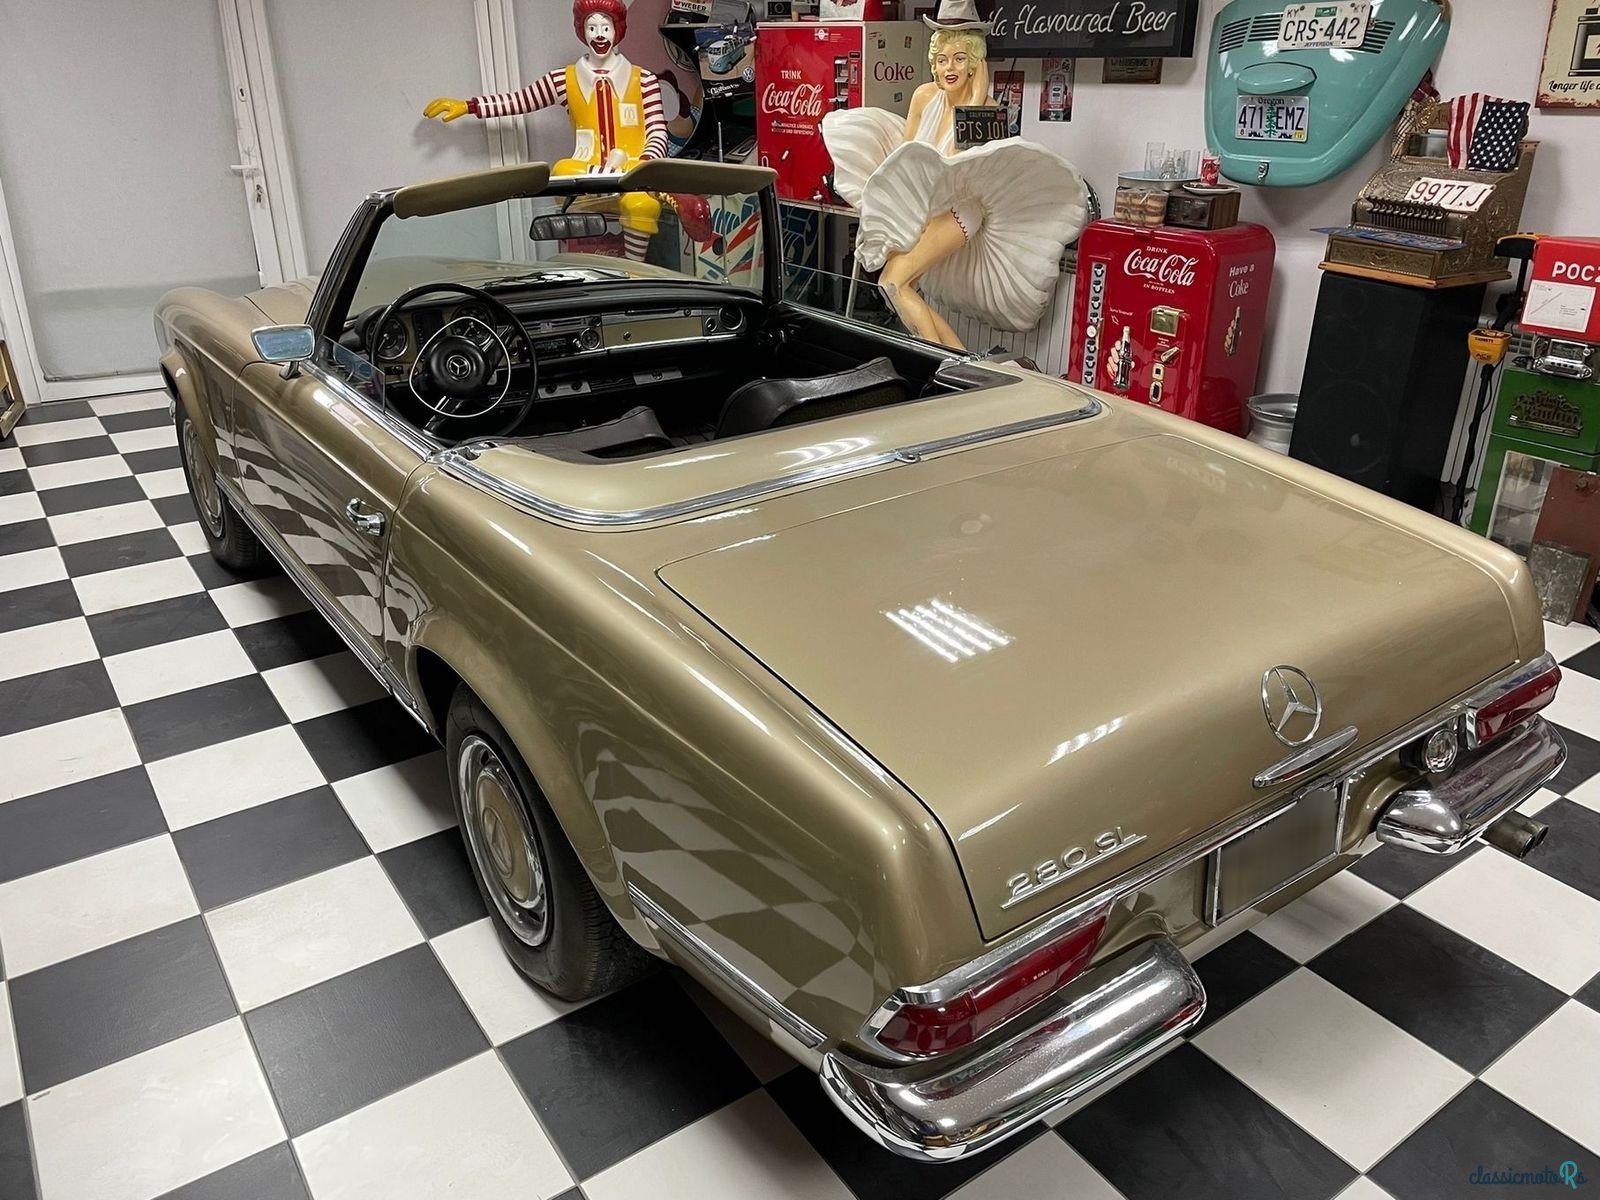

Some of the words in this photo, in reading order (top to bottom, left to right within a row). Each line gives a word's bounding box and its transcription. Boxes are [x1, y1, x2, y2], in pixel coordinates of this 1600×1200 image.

[681, 1, 707, 11] WEBER
[1287, 8, 1299, 17] KY
[1014, 2, 1119, 40] flavoured
[1122, 1, 1177, 34] Beer
[781, 70, 802, 80] TRINK
[874, 61, 914, 81] Coke
[1549, 80, 1579, 92] Longer
[1580, 80, 1595, 92] life
[762, 83, 823, 116] Coca-Cola
[1258, 97, 1285, 106] Oregon
[1238, 106, 1264, 129] 471
[1276, 107, 1305, 130] EMZ
[958, 121, 983, 140] PTS
[987, 121, 1005, 140] 101
[1146, 245, 1168, 254] DRINK
[1123, 248, 1199, 286] Coca-Cola
[1229, 265, 1248, 277] Have
[1249, 264, 1255, 272] a
[1151, 284, 1175, 294] BOTTLES
